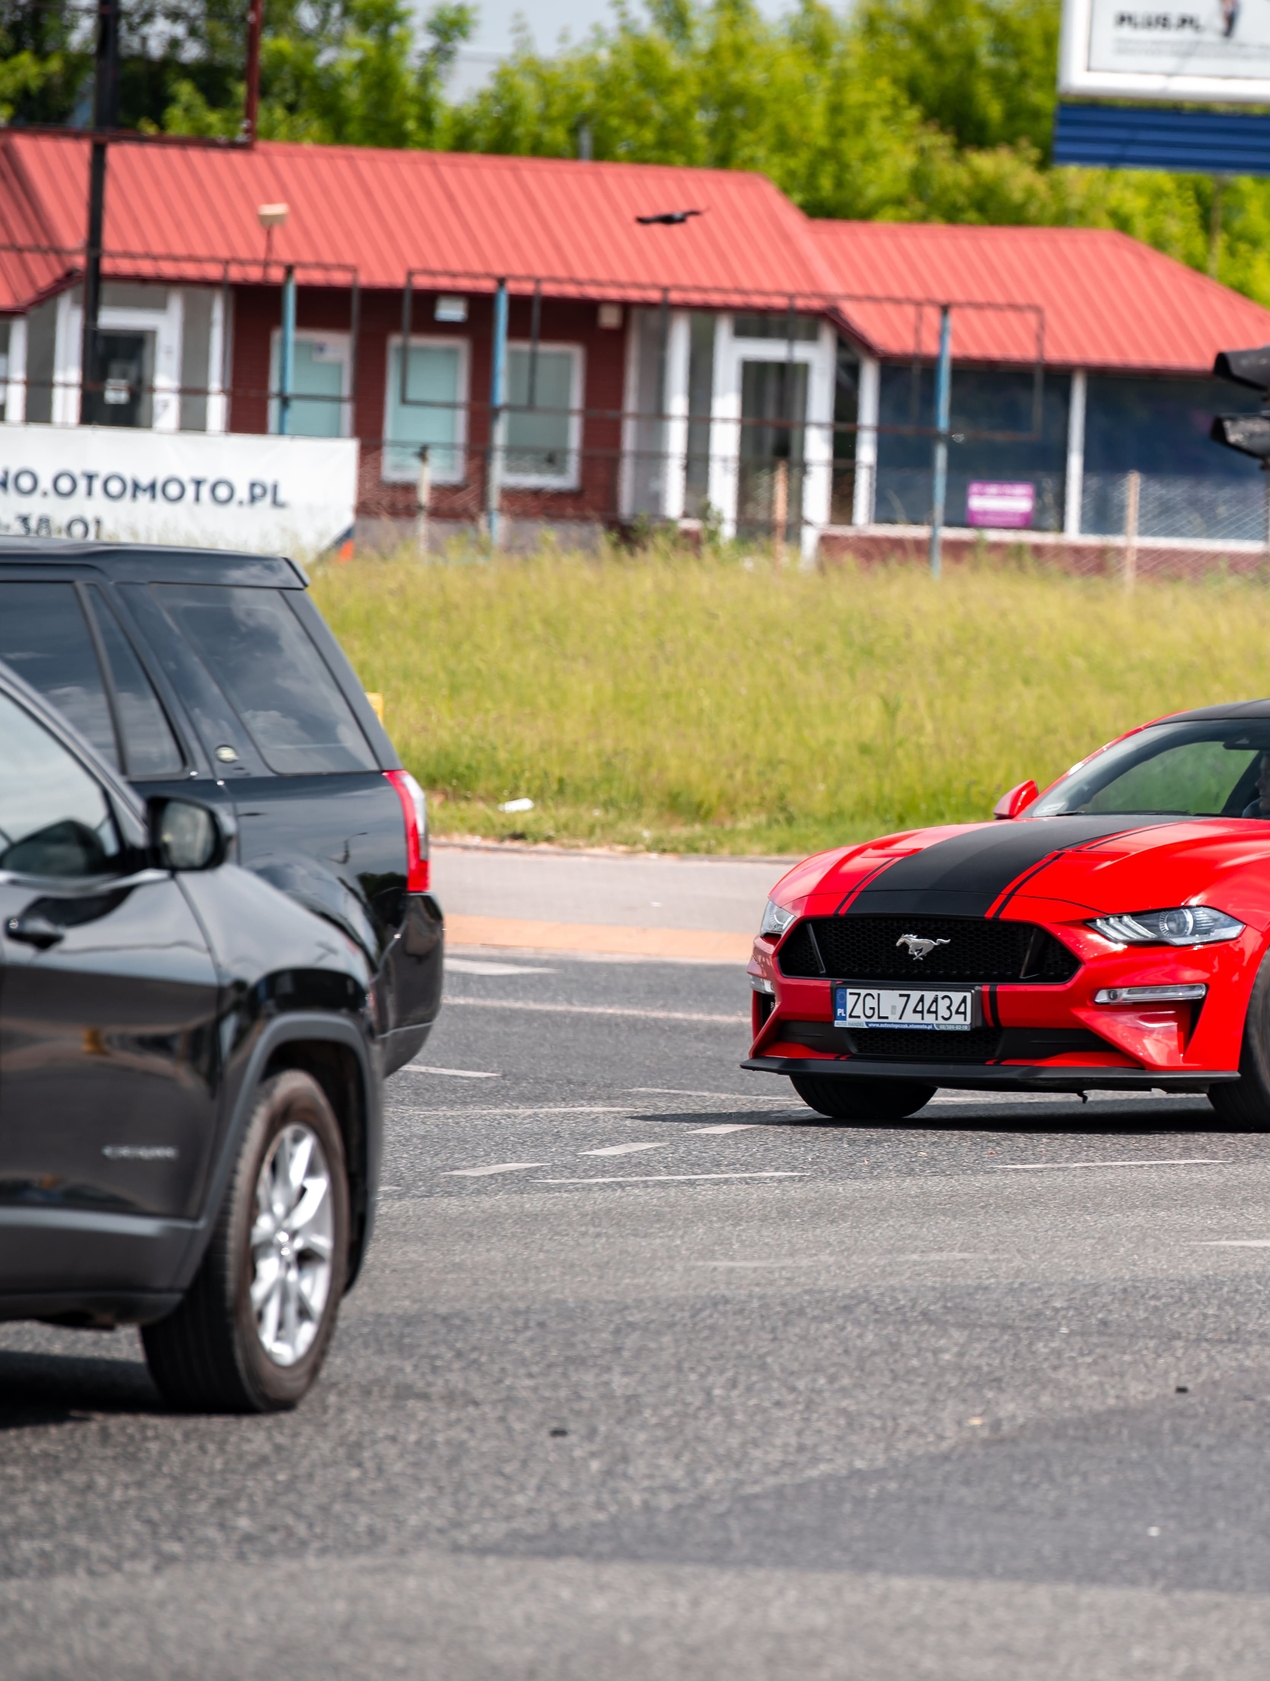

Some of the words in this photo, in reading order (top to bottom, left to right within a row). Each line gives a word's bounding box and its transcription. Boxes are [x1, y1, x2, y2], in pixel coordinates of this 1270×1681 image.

[837, 1008, 846, 1017] PL
[848, 992, 889, 1020] ZGL
[898, 993, 968, 1022] 74434
